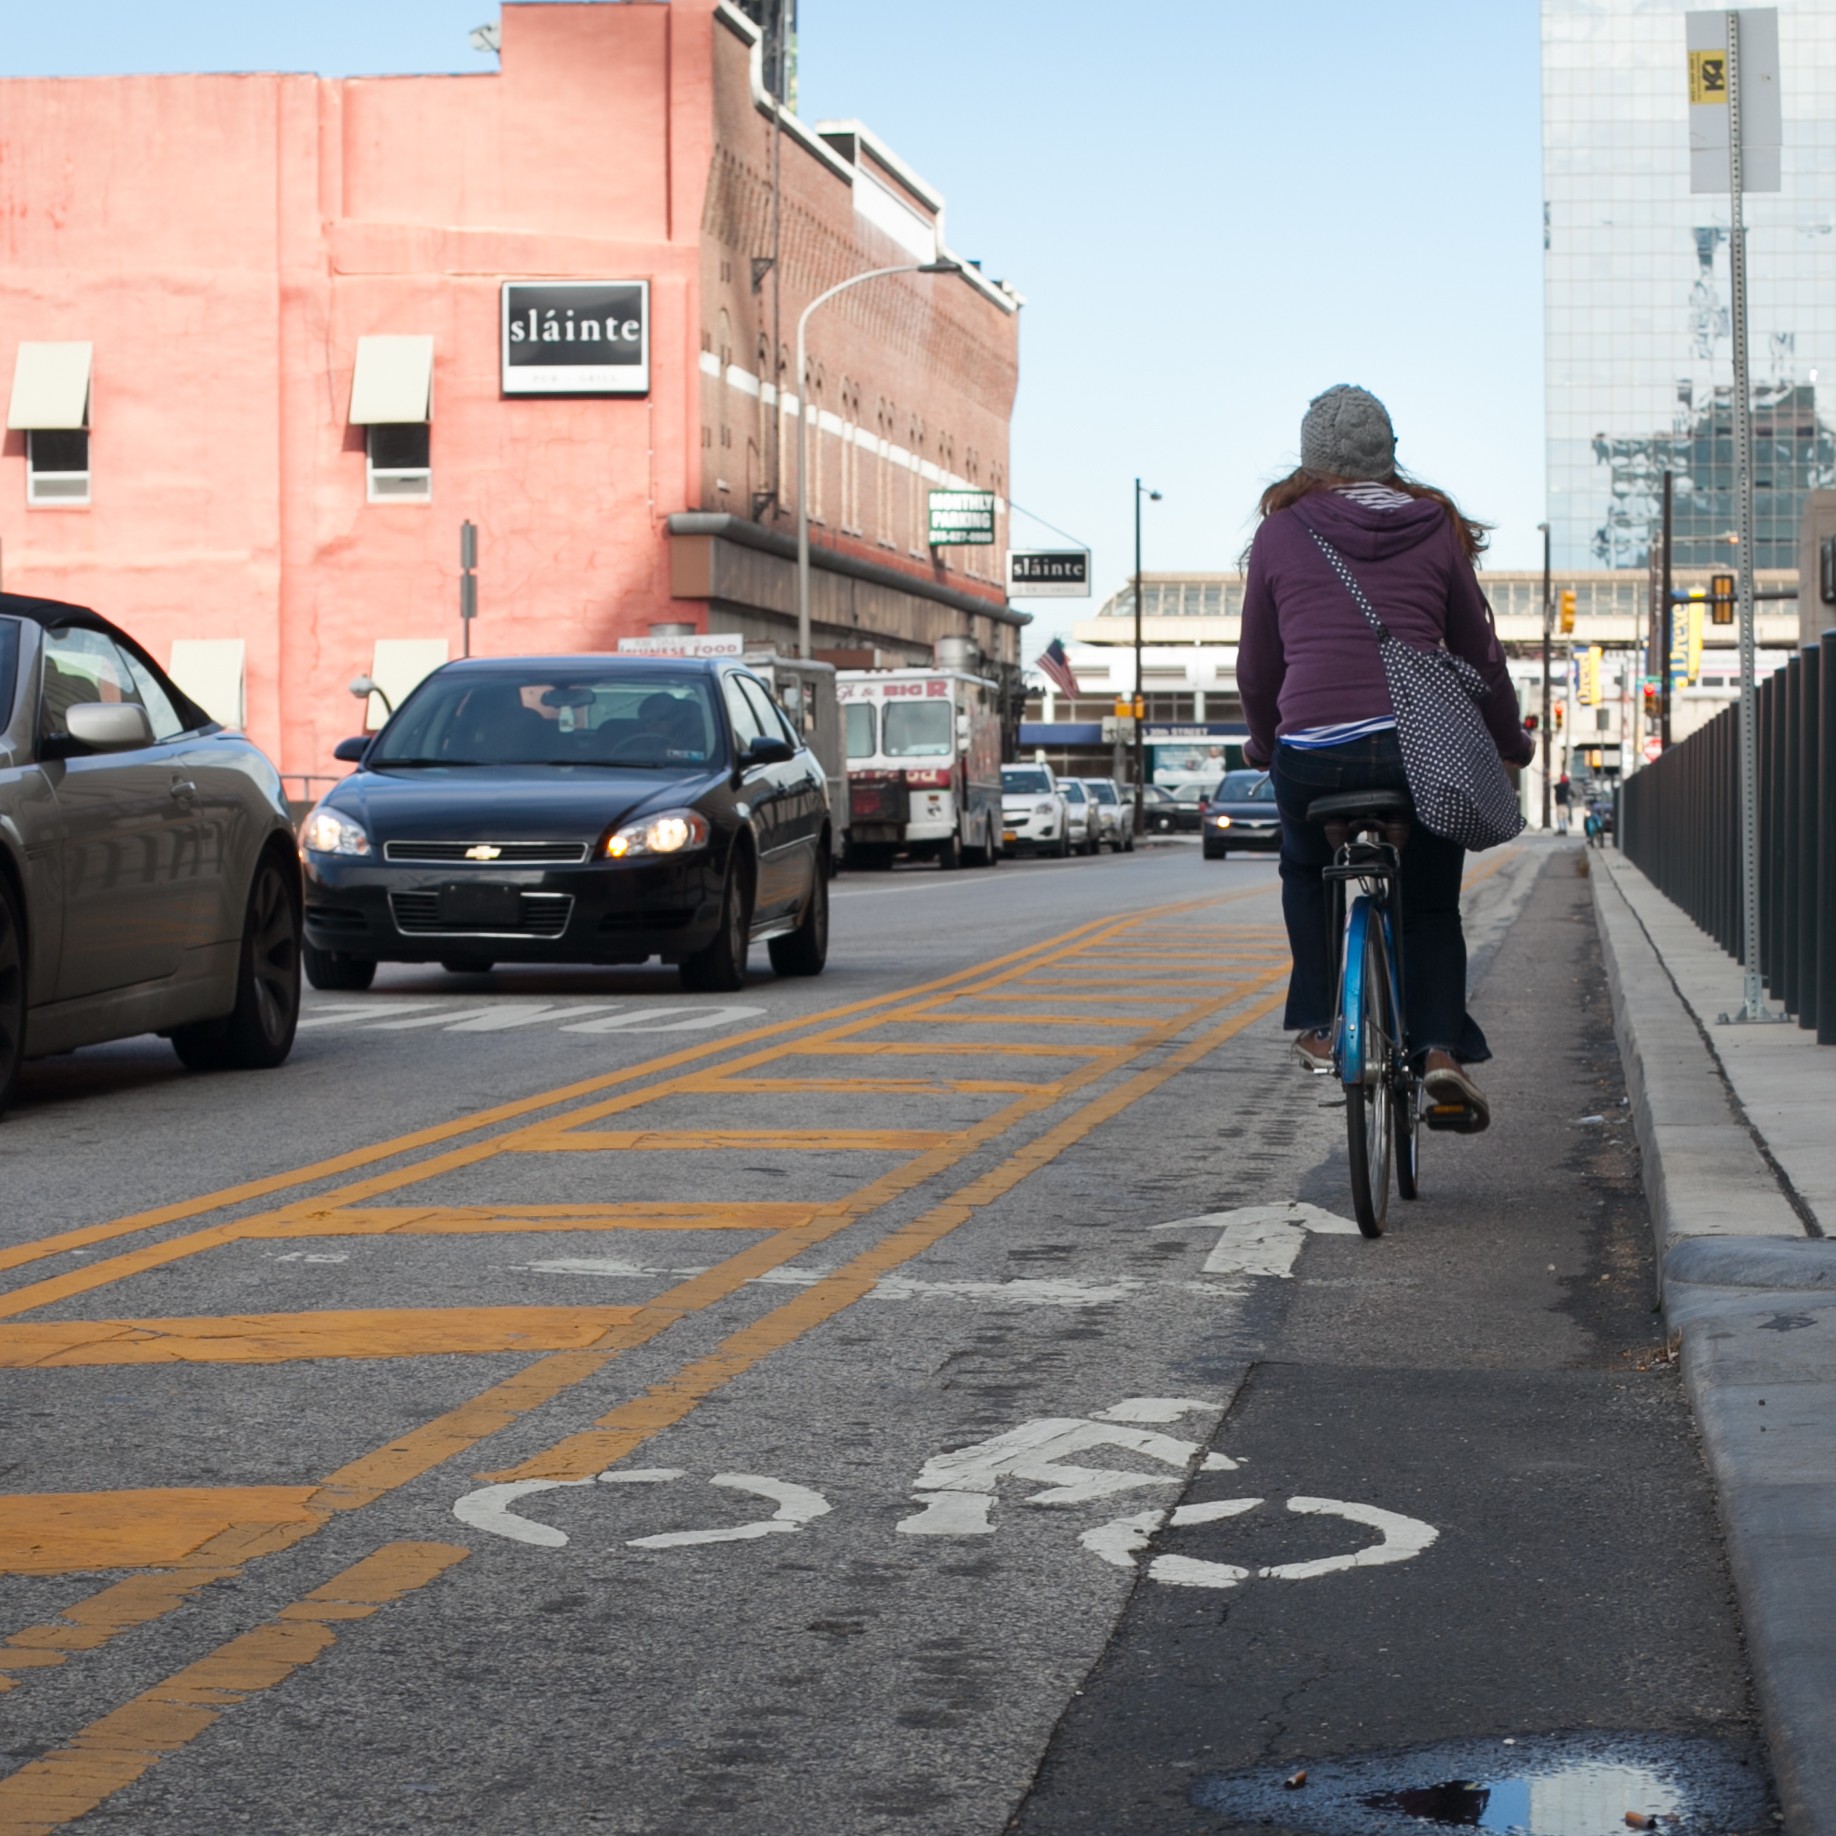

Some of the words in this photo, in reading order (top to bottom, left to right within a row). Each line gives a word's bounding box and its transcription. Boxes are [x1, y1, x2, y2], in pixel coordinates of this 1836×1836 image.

[510, 308, 640, 342] sláinte
[929, 492, 994, 510] MONTHLY
[931, 511, 991, 528] PARKING
[1013, 557, 1083, 576] sláinte
[1670, 602, 1688, 671] Drexe
[694, 644, 737, 656] FOOD
[882, 684, 923, 697] BIG
